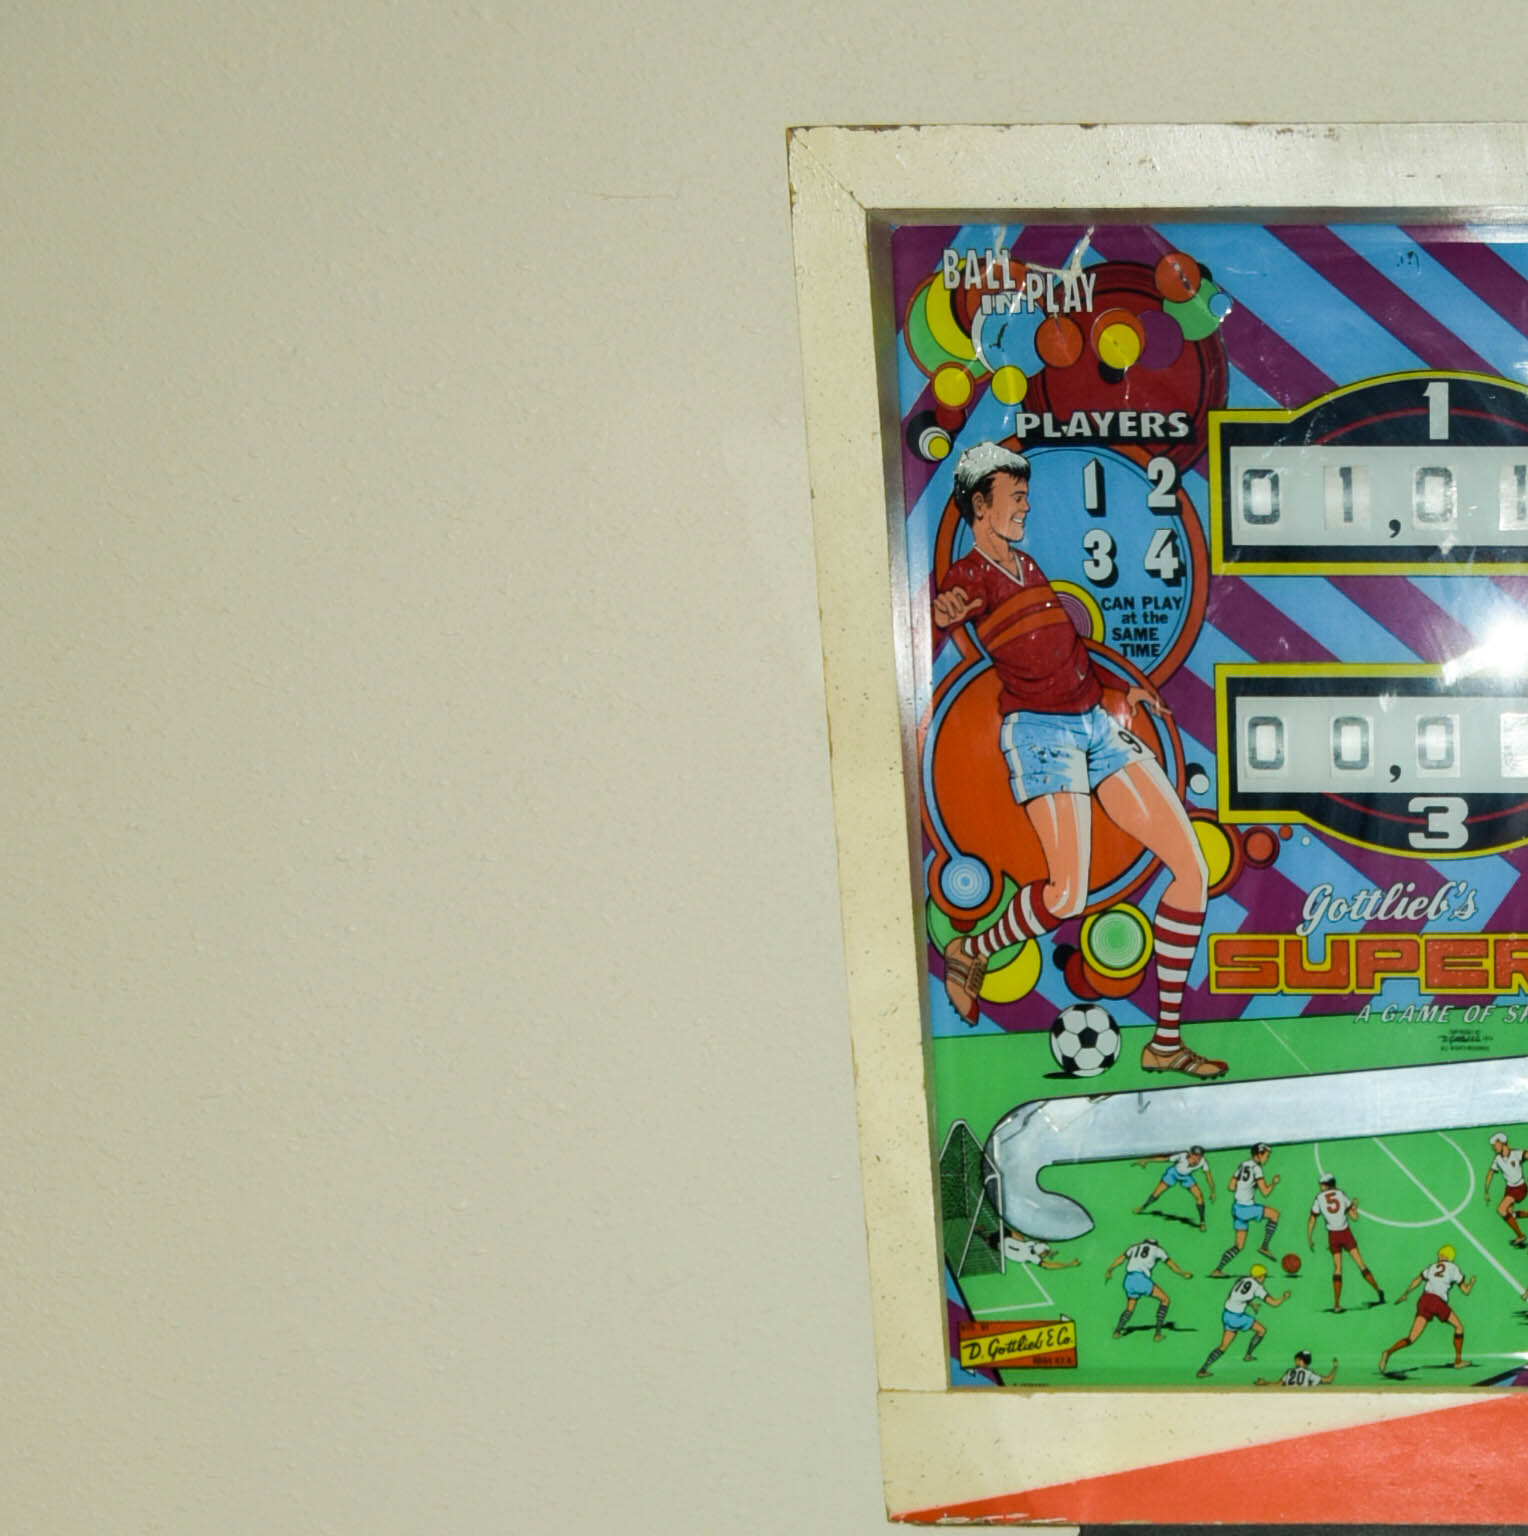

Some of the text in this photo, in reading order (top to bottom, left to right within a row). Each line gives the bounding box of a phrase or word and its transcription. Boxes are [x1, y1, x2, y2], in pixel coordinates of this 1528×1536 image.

[942, 248, 1097, 316] BALL IN PLAY
[1015, 410, 1190, 438] PLAYERS
[1422, 381, 1449, 440] 1
[1083, 456, 1177, 510] 1 2
[1083, 527, 1180, 581] 3 4
[1101, 596, 1184, 612] CAN PLAY
[1121, 611, 1169, 625] at the
[1111, 626, 1160, 642] SAME
[1120, 642, 1162, 658] TIME
[1406, 796, 1470, 850] 3
[1296, 883, 1478, 937] Gottlieb's
[1354, 1003, 1371, 1023] A
[1380, 1003, 1454, 1024] GAME
[1463, 1003, 1498, 1023] OF
[1324, 1191, 1341, 1215] 5
[1434, 1263, 1446, 1278] 2
[988, 1332, 1045, 1361] Gottlieb
[1057, 1326, 1073, 1346] Co.
